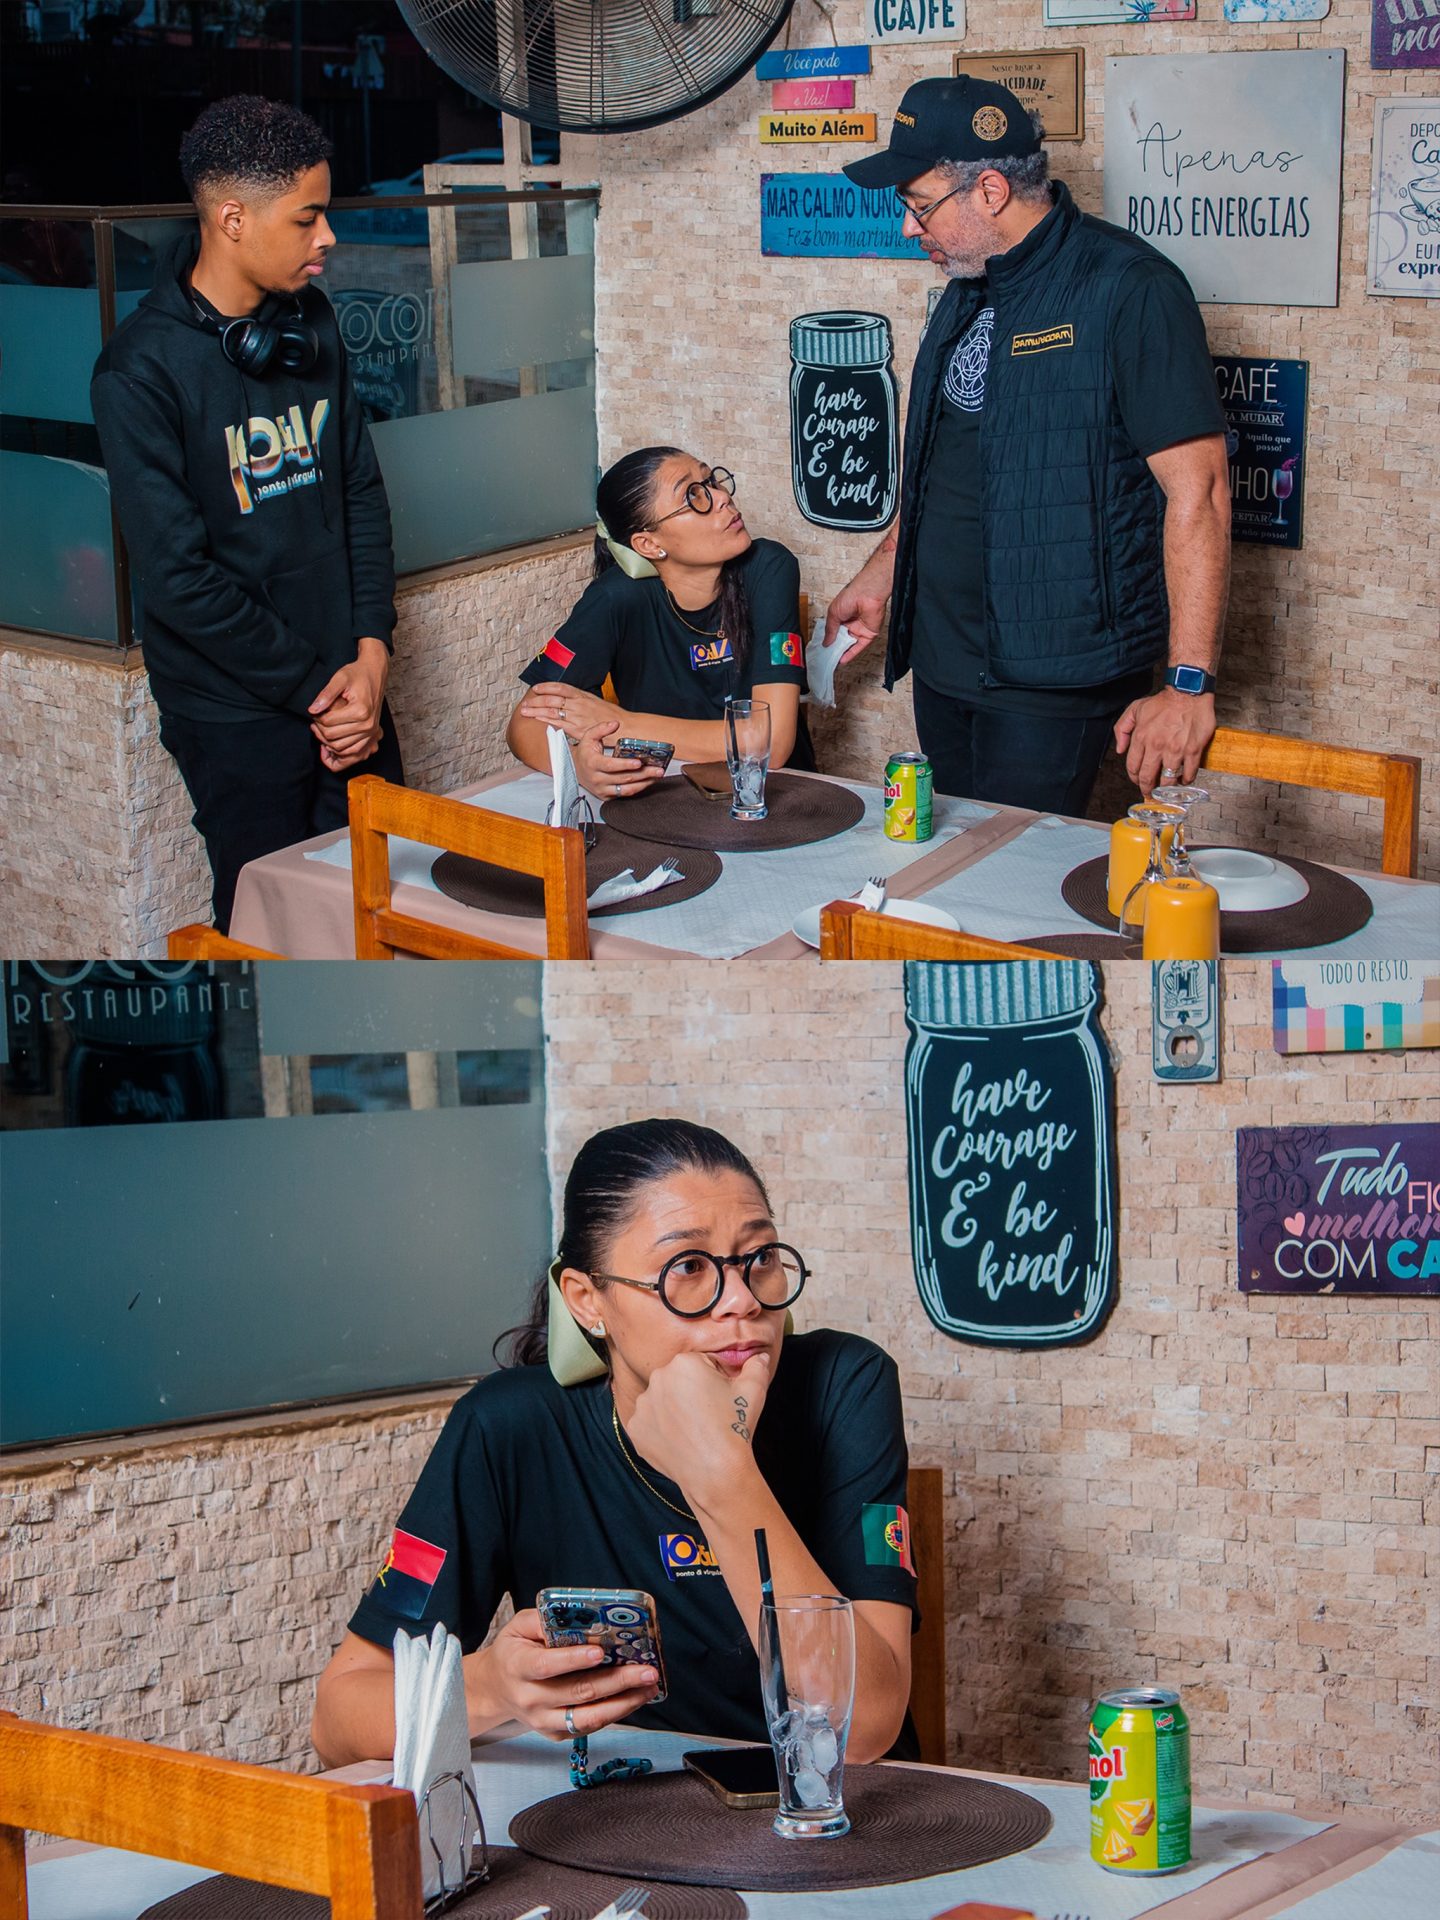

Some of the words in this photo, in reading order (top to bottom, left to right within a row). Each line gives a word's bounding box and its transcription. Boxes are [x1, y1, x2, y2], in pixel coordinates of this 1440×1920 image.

[812, 56, 841, 76] pode
[801, 85, 830, 106] Vai!
[769, 120, 817, 138] Muito
[821, 117, 864, 137] Além
[1137, 121, 1304, 188] Apenas
[767, 189, 799, 218] MAR
[802, 187, 854, 219] CALMO
[860, 186, 905, 219] NUNC
[1128, 195, 1184, 237] BOAS
[1191, 196, 1310, 238] ENERGIAS
[786, 227, 811, 246] Fez
[812, 220, 837, 246] bom
[1416, 243, 1433, 259] EU
[814, 381, 867, 415] have
[1215, 362, 1279, 403] CAFÉ
[803, 413, 879, 442] Courage
[1240, 412, 1280, 424] MUDAR
[1245, 433, 1273, 443] Aquilo
[1275, 436, 1292, 444] que
[841, 445, 869, 475] be
[827, 474, 880, 507] kind
[1320, 962, 1353, 984] TODO
[1358, 963, 1366, 983] O
[1371, 960, 1413, 982] RESTO.
[952, 1061, 1052, 1127] have
[932, 1122, 1077, 1179] Courage
[1315, 1142, 1409, 1206] Tudo
[941, 1171, 991, 1247] &
[1005, 1181, 1058, 1237] be
[1308, 1199, 1440, 1240] melhor
[978, 1233, 1080, 1302] kind
[1274, 1239, 1377, 1279] COM
